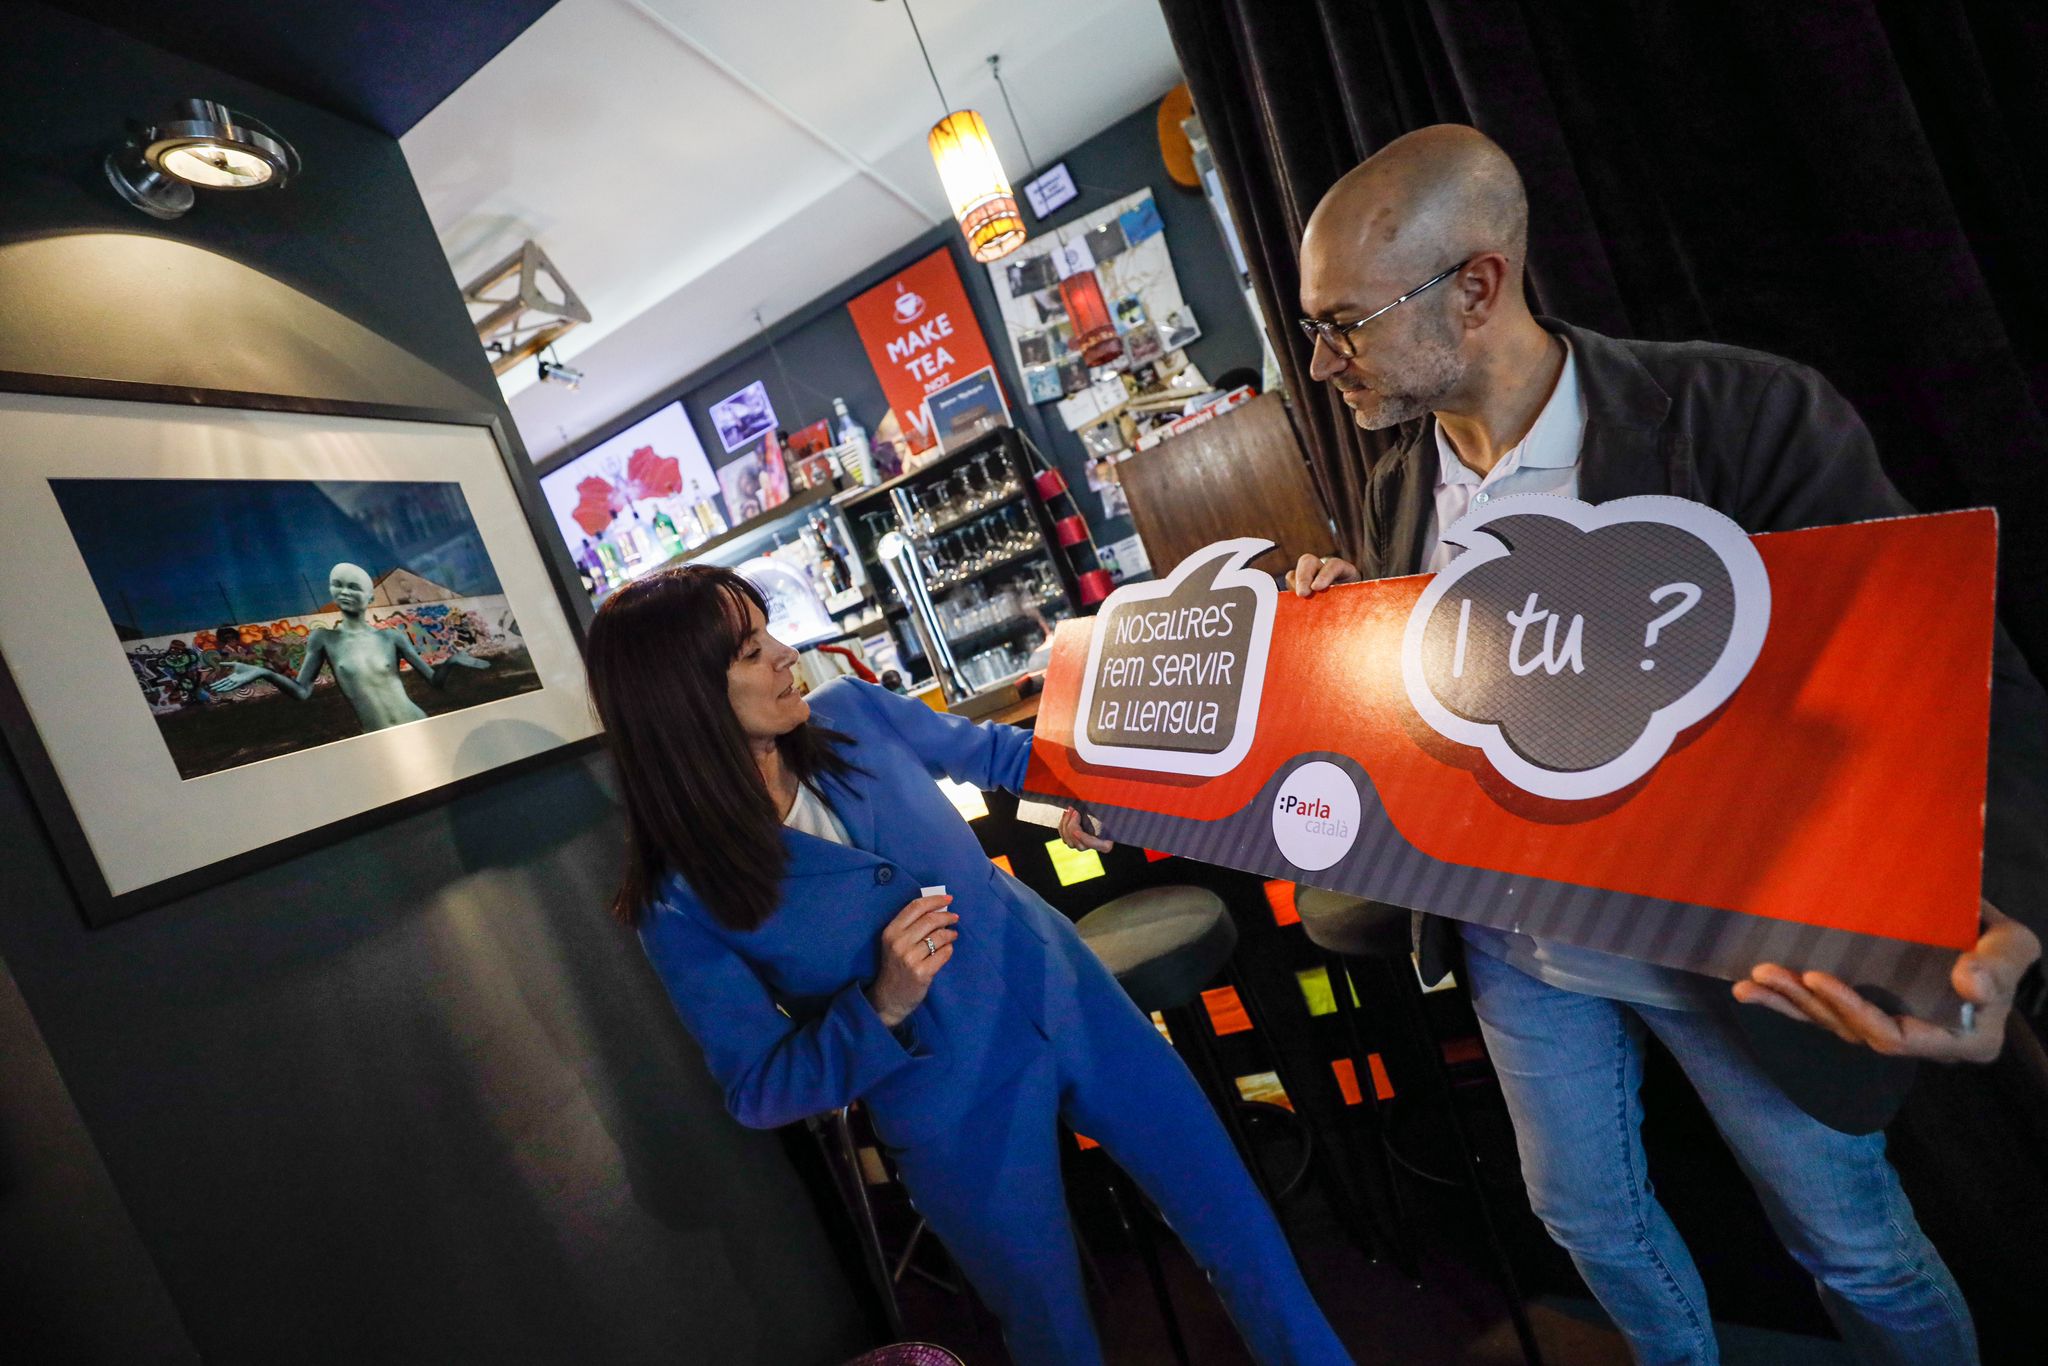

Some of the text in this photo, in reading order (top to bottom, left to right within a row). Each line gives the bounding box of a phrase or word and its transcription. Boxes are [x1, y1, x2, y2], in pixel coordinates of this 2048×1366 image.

[886, 313, 953, 364] MAKE
[905, 346, 956, 381] TEA
[924, 372, 950, 393] NOT
[1453, 582, 1701, 678] I tu ?
[1101, 656, 1144, 688] fem
[1305, 819, 1348, 839] català
